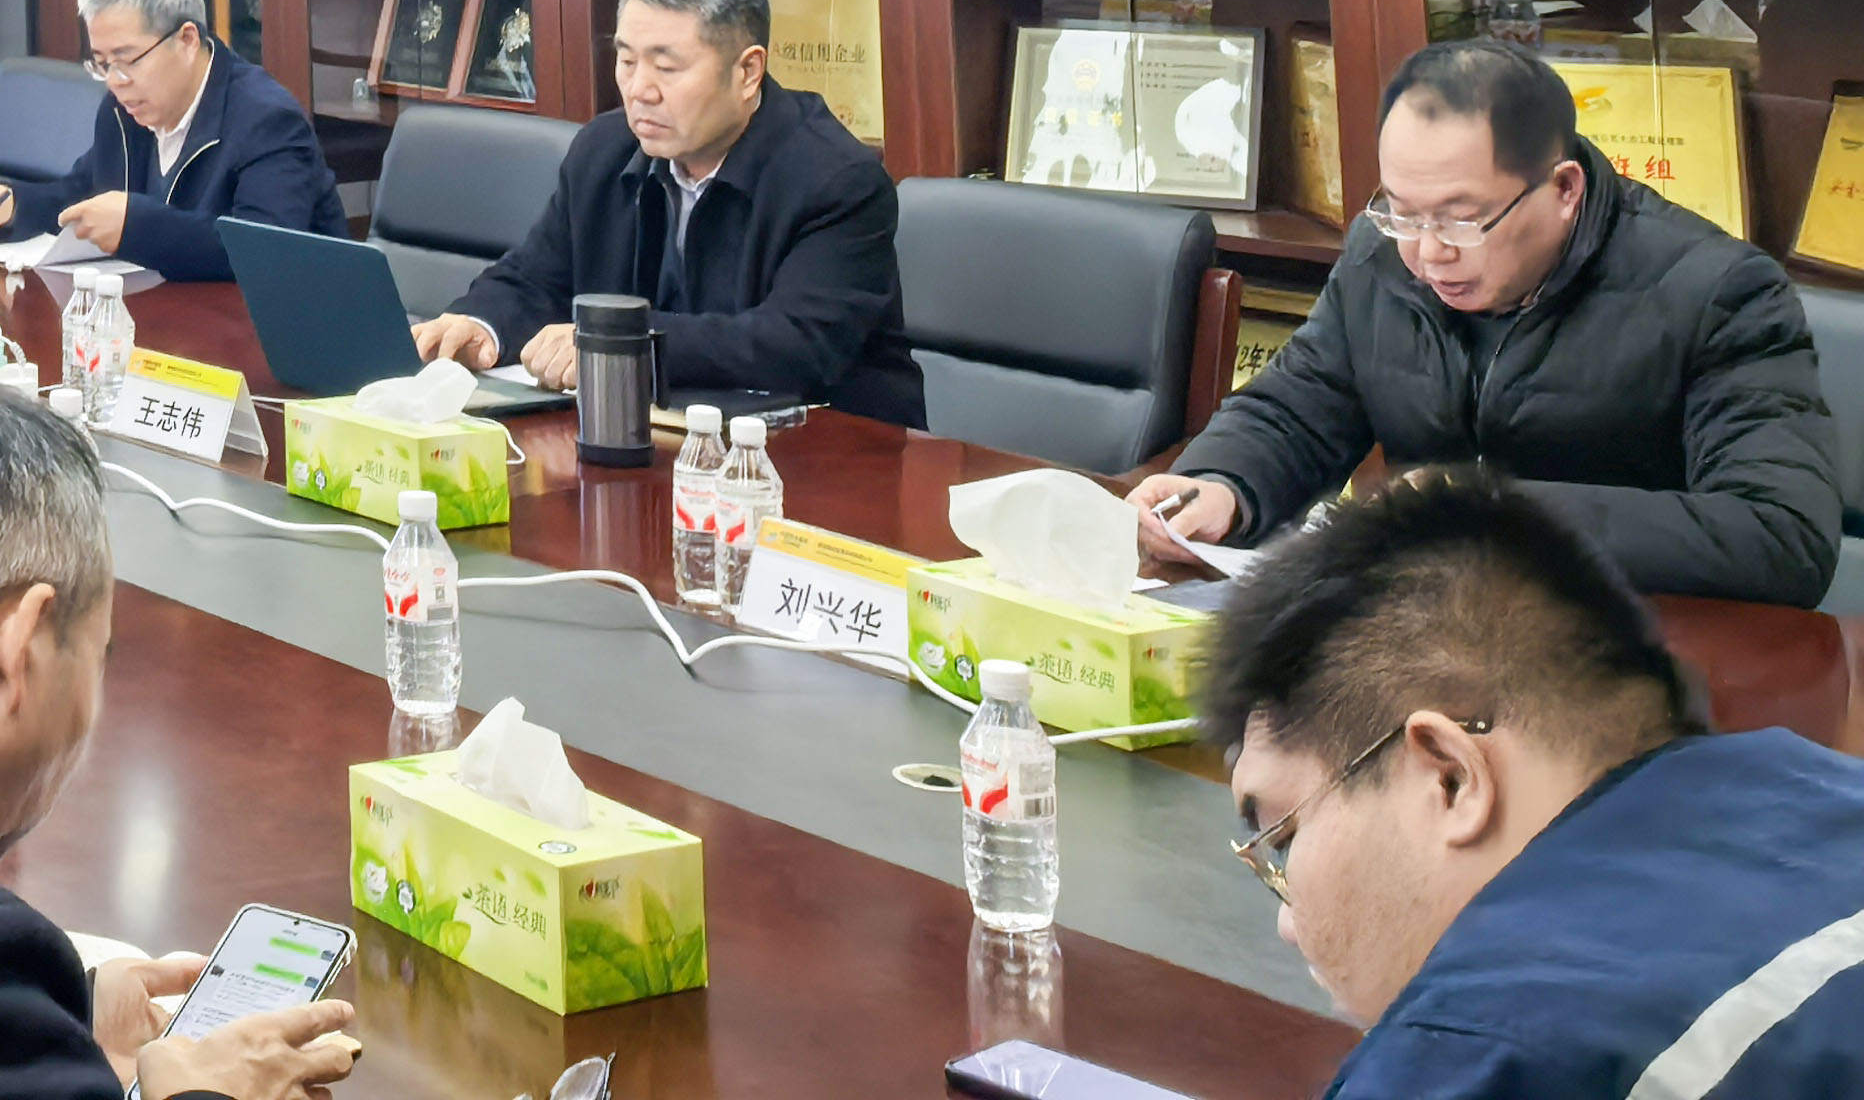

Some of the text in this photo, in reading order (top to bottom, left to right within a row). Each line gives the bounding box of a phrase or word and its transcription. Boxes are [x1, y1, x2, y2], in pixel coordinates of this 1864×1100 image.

[133, 395, 207, 440] 王志伟
[774, 575, 884, 644] 刘兴华
